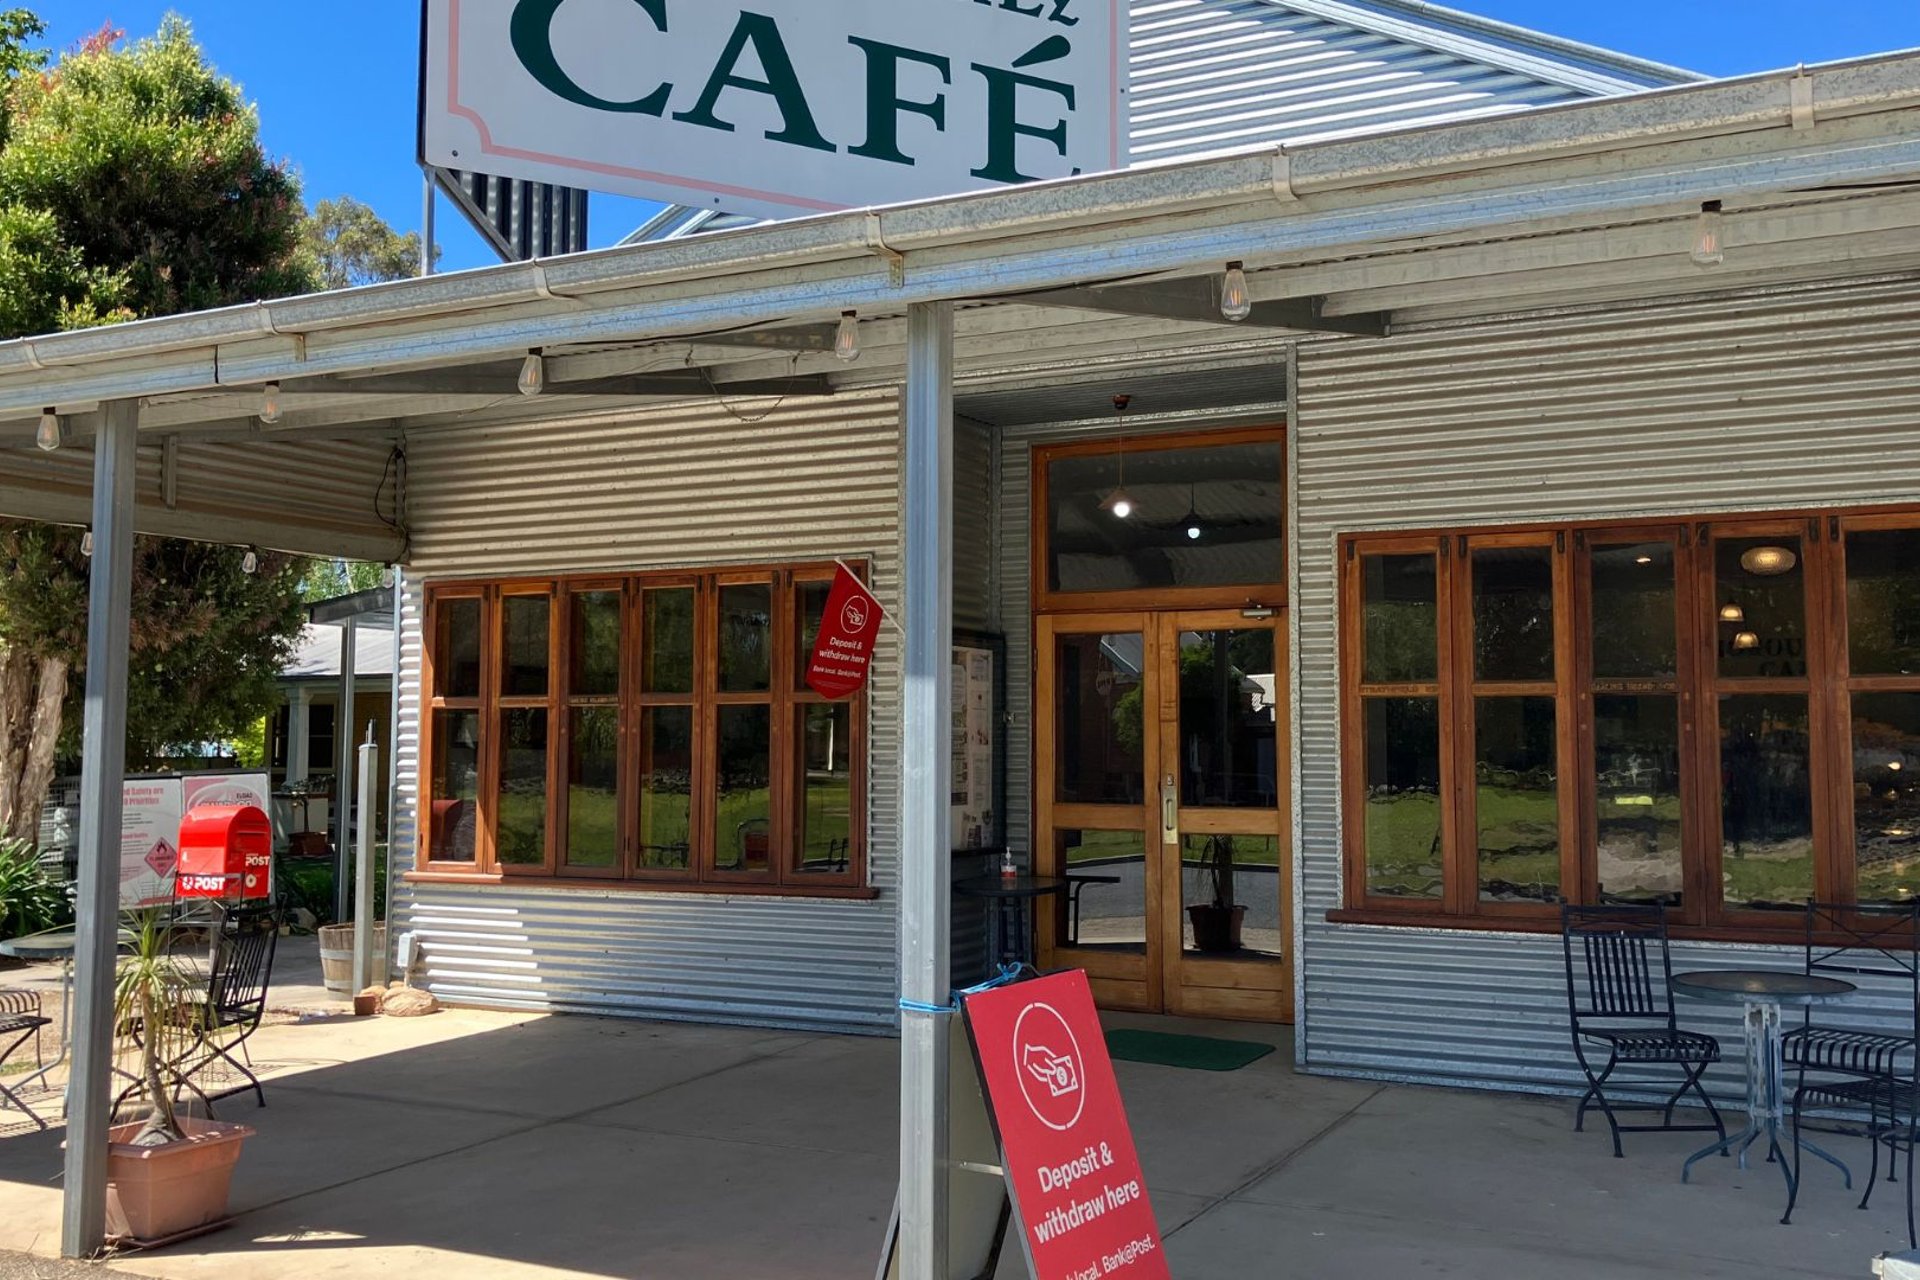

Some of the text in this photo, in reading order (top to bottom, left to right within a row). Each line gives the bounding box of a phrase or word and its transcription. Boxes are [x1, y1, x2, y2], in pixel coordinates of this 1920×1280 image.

[510, 0, 1081, 183] CAFÉ
[819, 649, 865, 664] withdraw here
[829, 636, 863, 650] Deposit &
[245, 855, 270, 867] POST
[194, 876, 226, 891] POST
[1037, 1141, 1114, 1193] Deposit &
[1034, 1179, 1140, 1244] withdraw here
[1102, 1233, 1155, 1274] Bank@Post.
